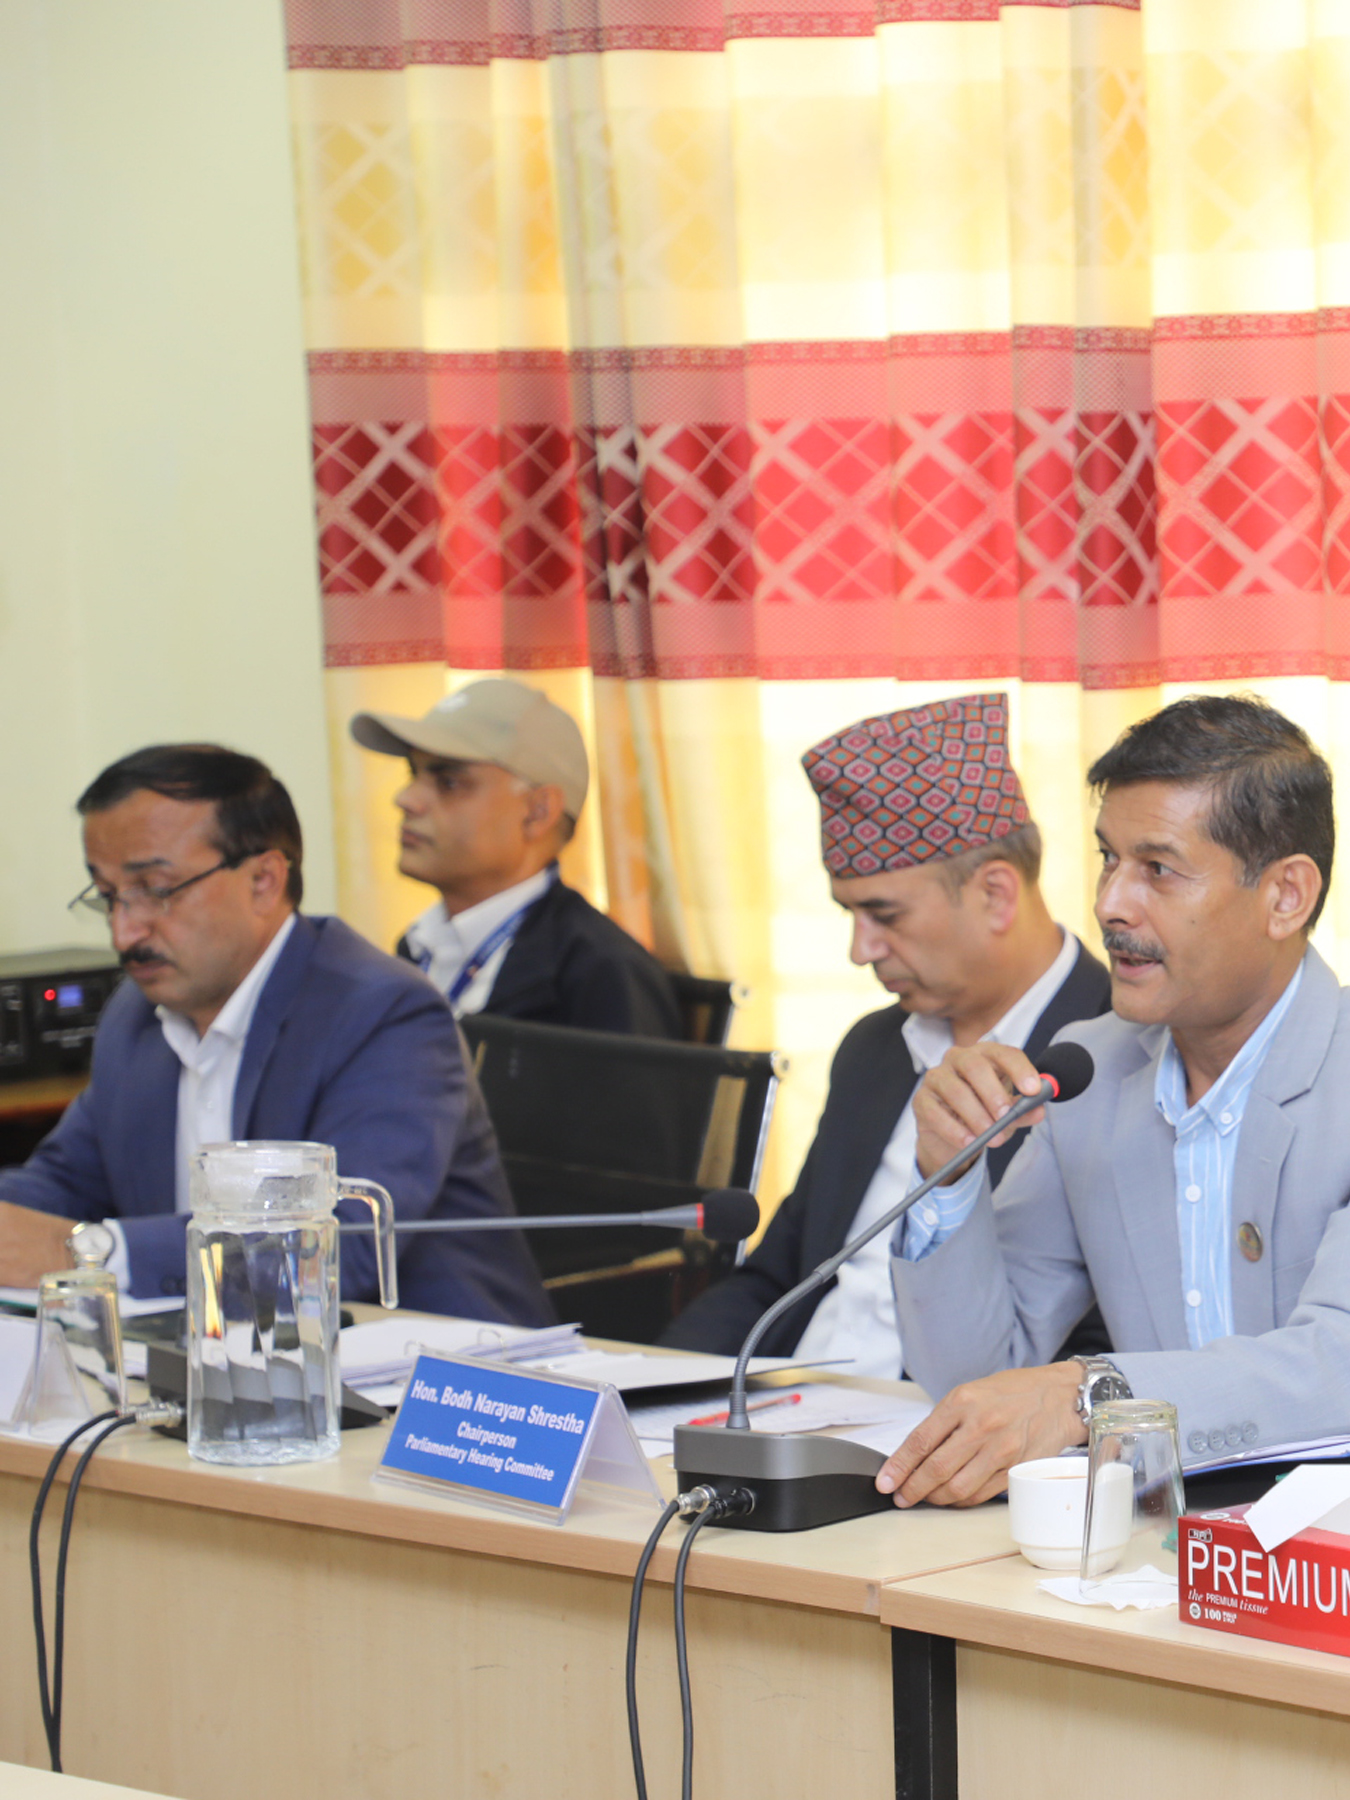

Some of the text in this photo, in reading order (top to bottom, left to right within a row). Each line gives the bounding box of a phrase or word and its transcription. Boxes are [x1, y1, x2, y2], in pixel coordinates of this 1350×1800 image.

[410, 1379, 586, 1435] Hon. Bodh Narayan Shrestha
[457, 1420, 517, 1450] Chairperson
[404, 1434, 555, 1482] Parliamentary Hearing Committee
[1188, 1588, 1270, 1615] the PREMIUM tissue
[1204, 1607, 1222, 1622] 100
